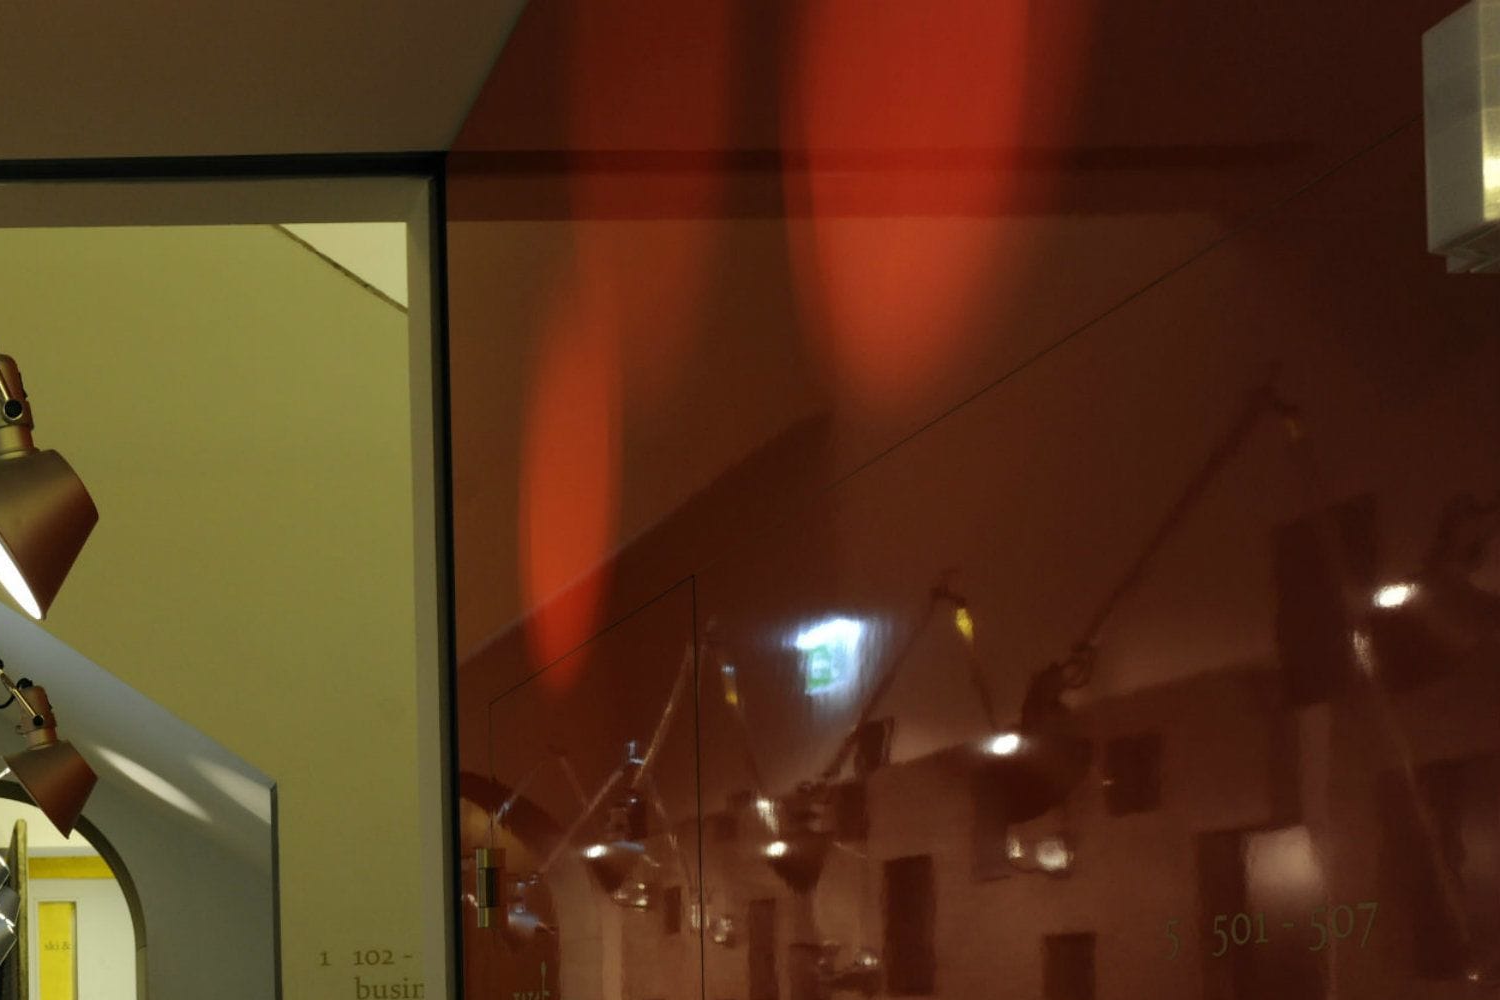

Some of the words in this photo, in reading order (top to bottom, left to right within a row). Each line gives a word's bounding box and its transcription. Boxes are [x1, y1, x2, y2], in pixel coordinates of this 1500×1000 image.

[1164, 916, 1183, 960] 5
[1212, 912, 1269, 957] 501
[1308, 901, 1380, 951] 507
[320, 951, 330, 967] 1
[353, 949, 395, 966] 102
